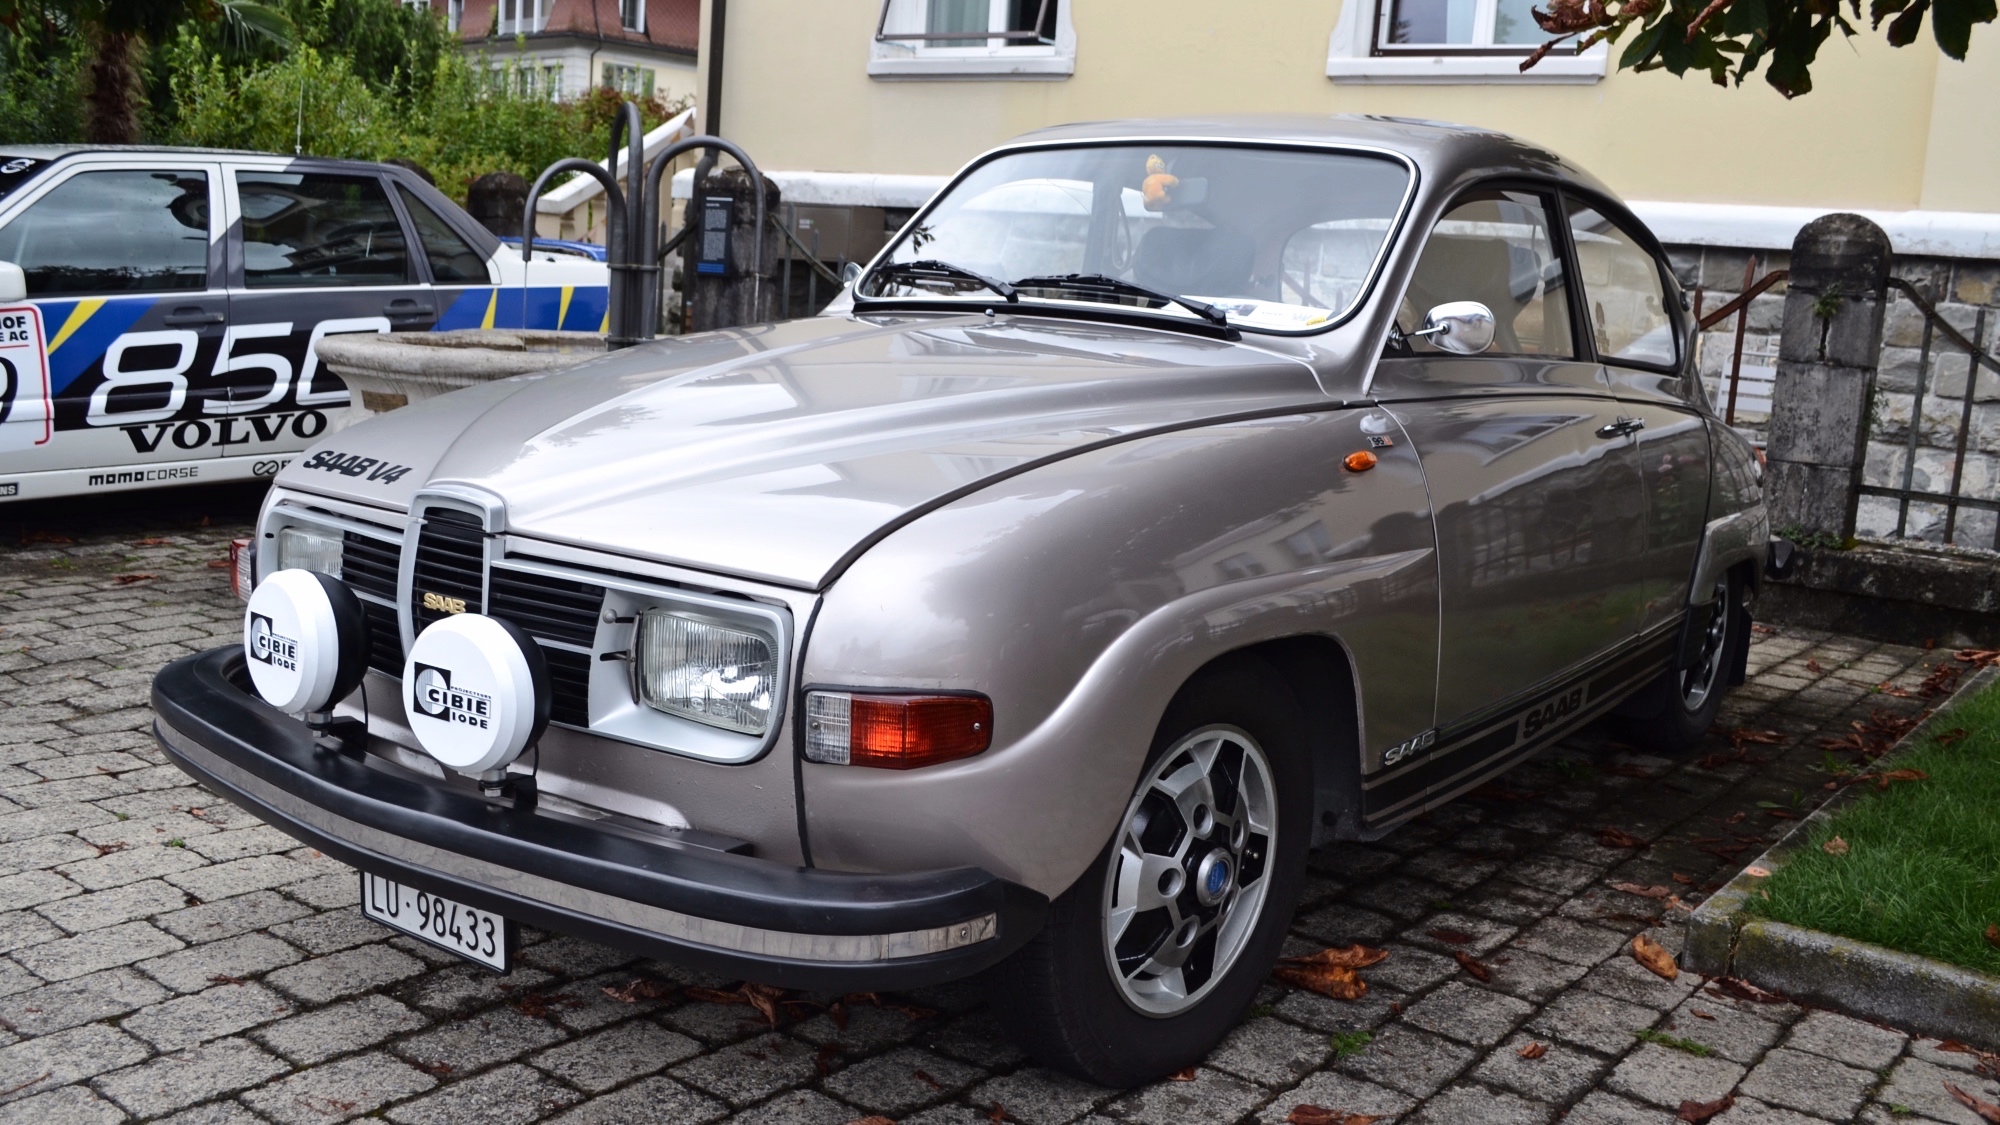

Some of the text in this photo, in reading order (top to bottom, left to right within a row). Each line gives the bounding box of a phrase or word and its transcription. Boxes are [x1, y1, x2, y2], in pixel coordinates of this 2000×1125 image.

[9, 330, 29, 341] AG
[119, 409, 328, 454] VOLVO
[303, 450, 379, 478] SAAB
[366, 461, 413, 485] V4
[423, 592, 466, 615] SAAB
[259, 635, 296, 659] CIBIE
[273, 656, 296, 672] IODE
[428, 688, 488, 716] CIBIE
[1522, 687, 1583, 739] SAAB
[452, 711, 488, 730] IODE
[1384, 730, 1436, 766] SAAB
